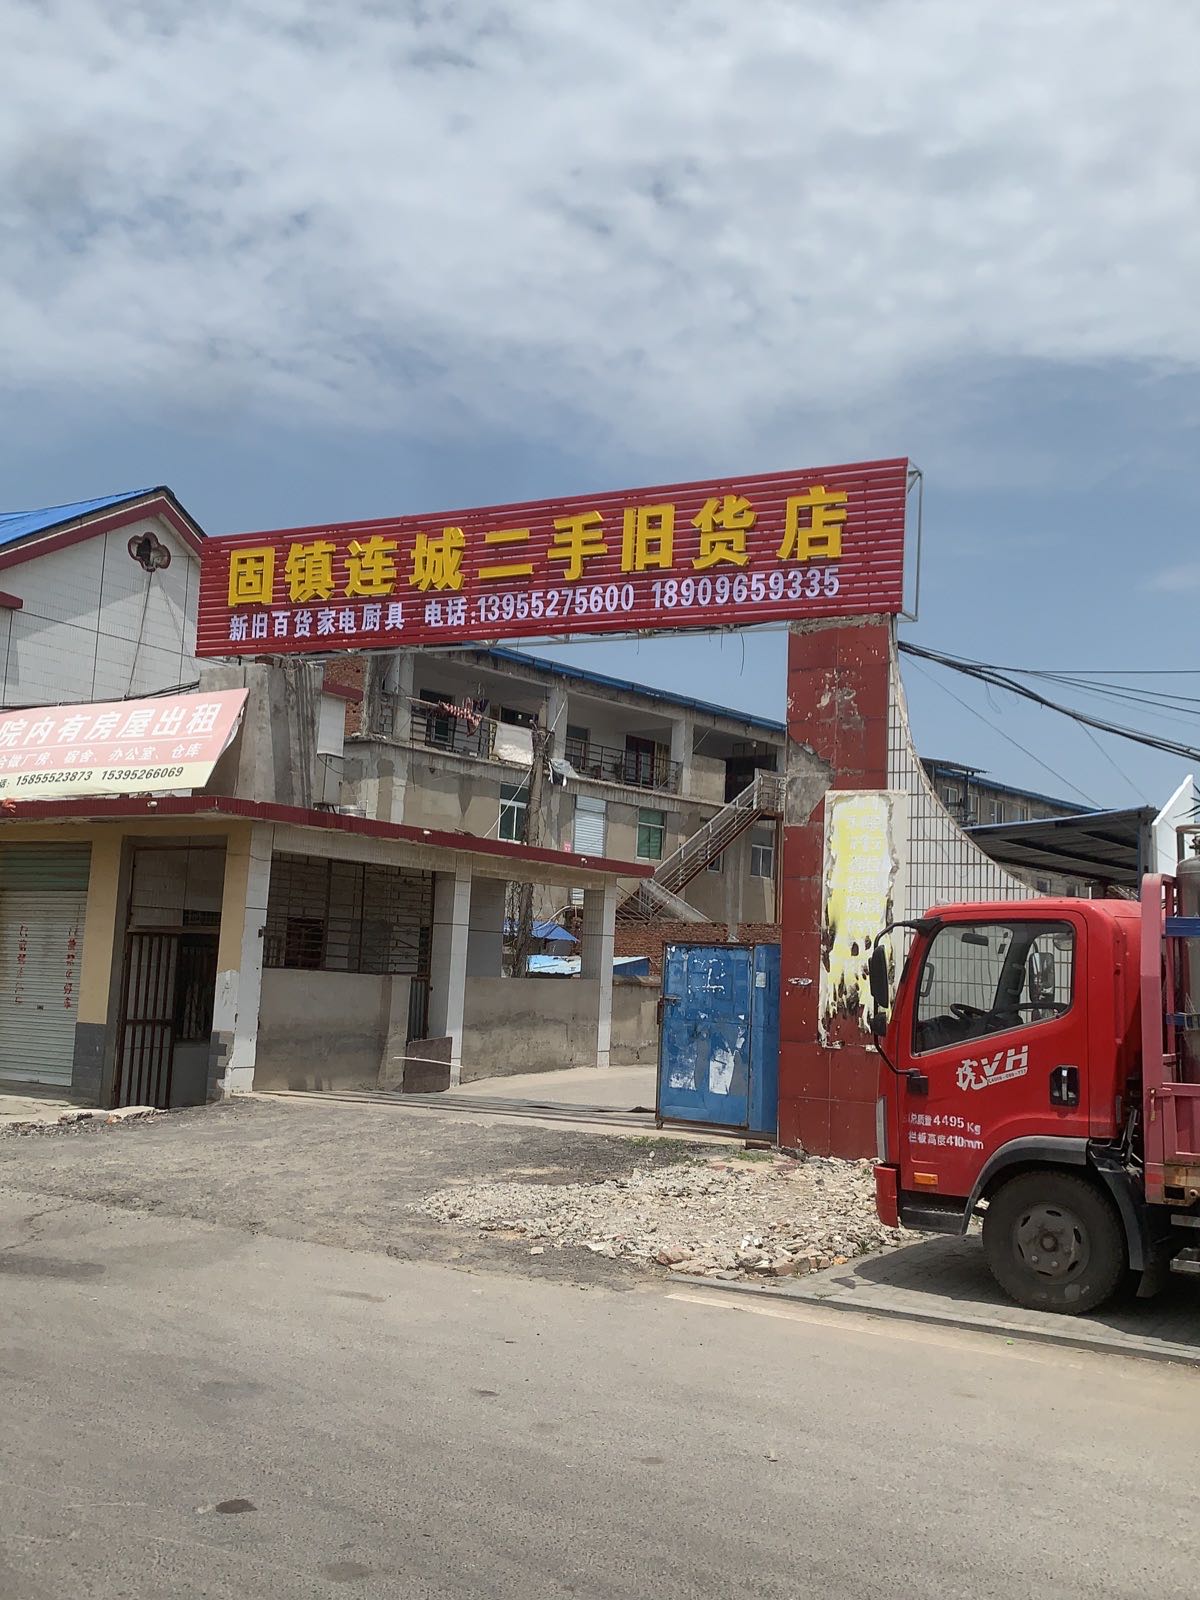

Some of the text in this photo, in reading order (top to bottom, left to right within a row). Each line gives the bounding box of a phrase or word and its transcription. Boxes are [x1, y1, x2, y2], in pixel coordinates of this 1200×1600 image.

[227, 485, 848, 608] 固镇连城二手旧货店
[228, 601, 405, 642] 新旧百货家电厨具
[651, 567, 840, 608] 18909659335
[0, 702, 222, 747] 院内有房屋出租
[101, 766, 184, 781] 15395266069
